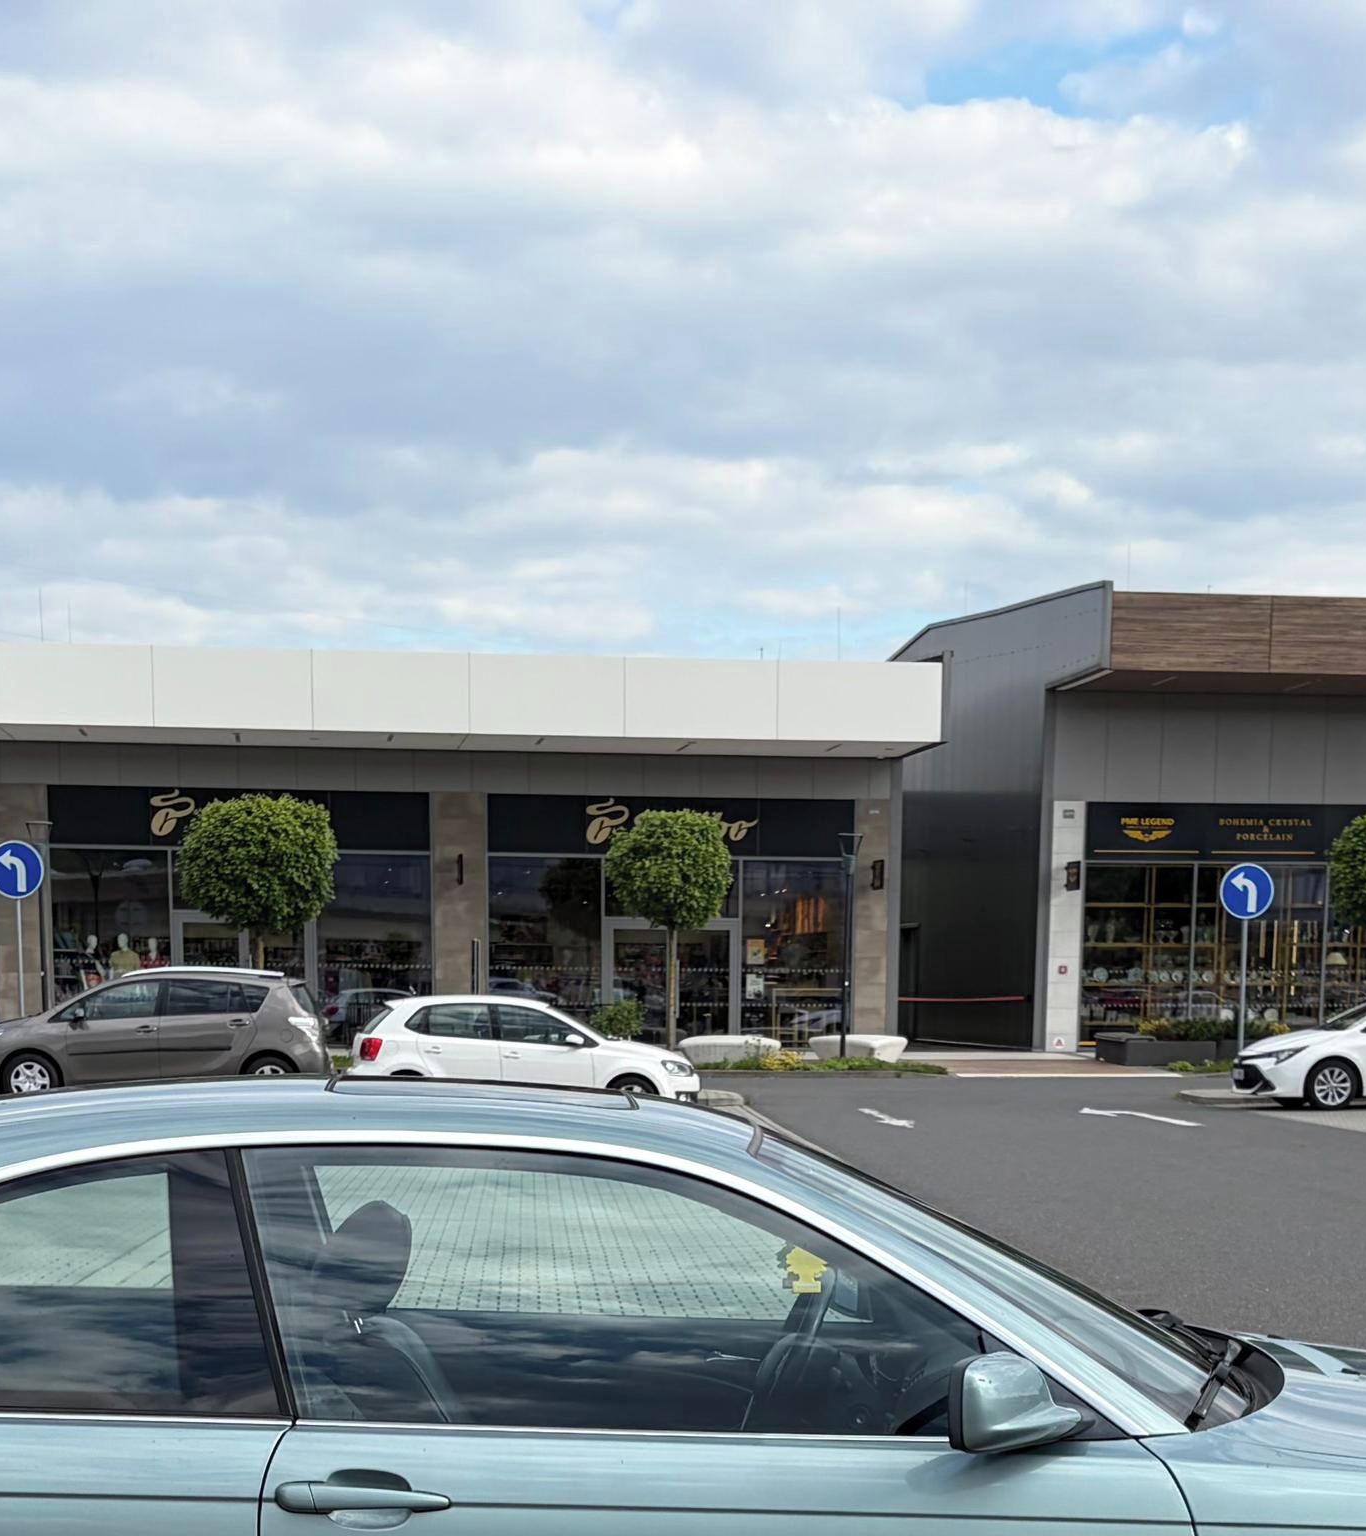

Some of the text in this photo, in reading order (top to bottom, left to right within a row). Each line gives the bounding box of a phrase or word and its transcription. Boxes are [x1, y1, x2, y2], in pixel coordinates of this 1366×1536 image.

[1141, 818, 1175, 826] LEGEND
[1218, 818, 1313, 827] BOHEMIA CRYSTAL
[1236, 832, 1293, 841] PORCELAIN
